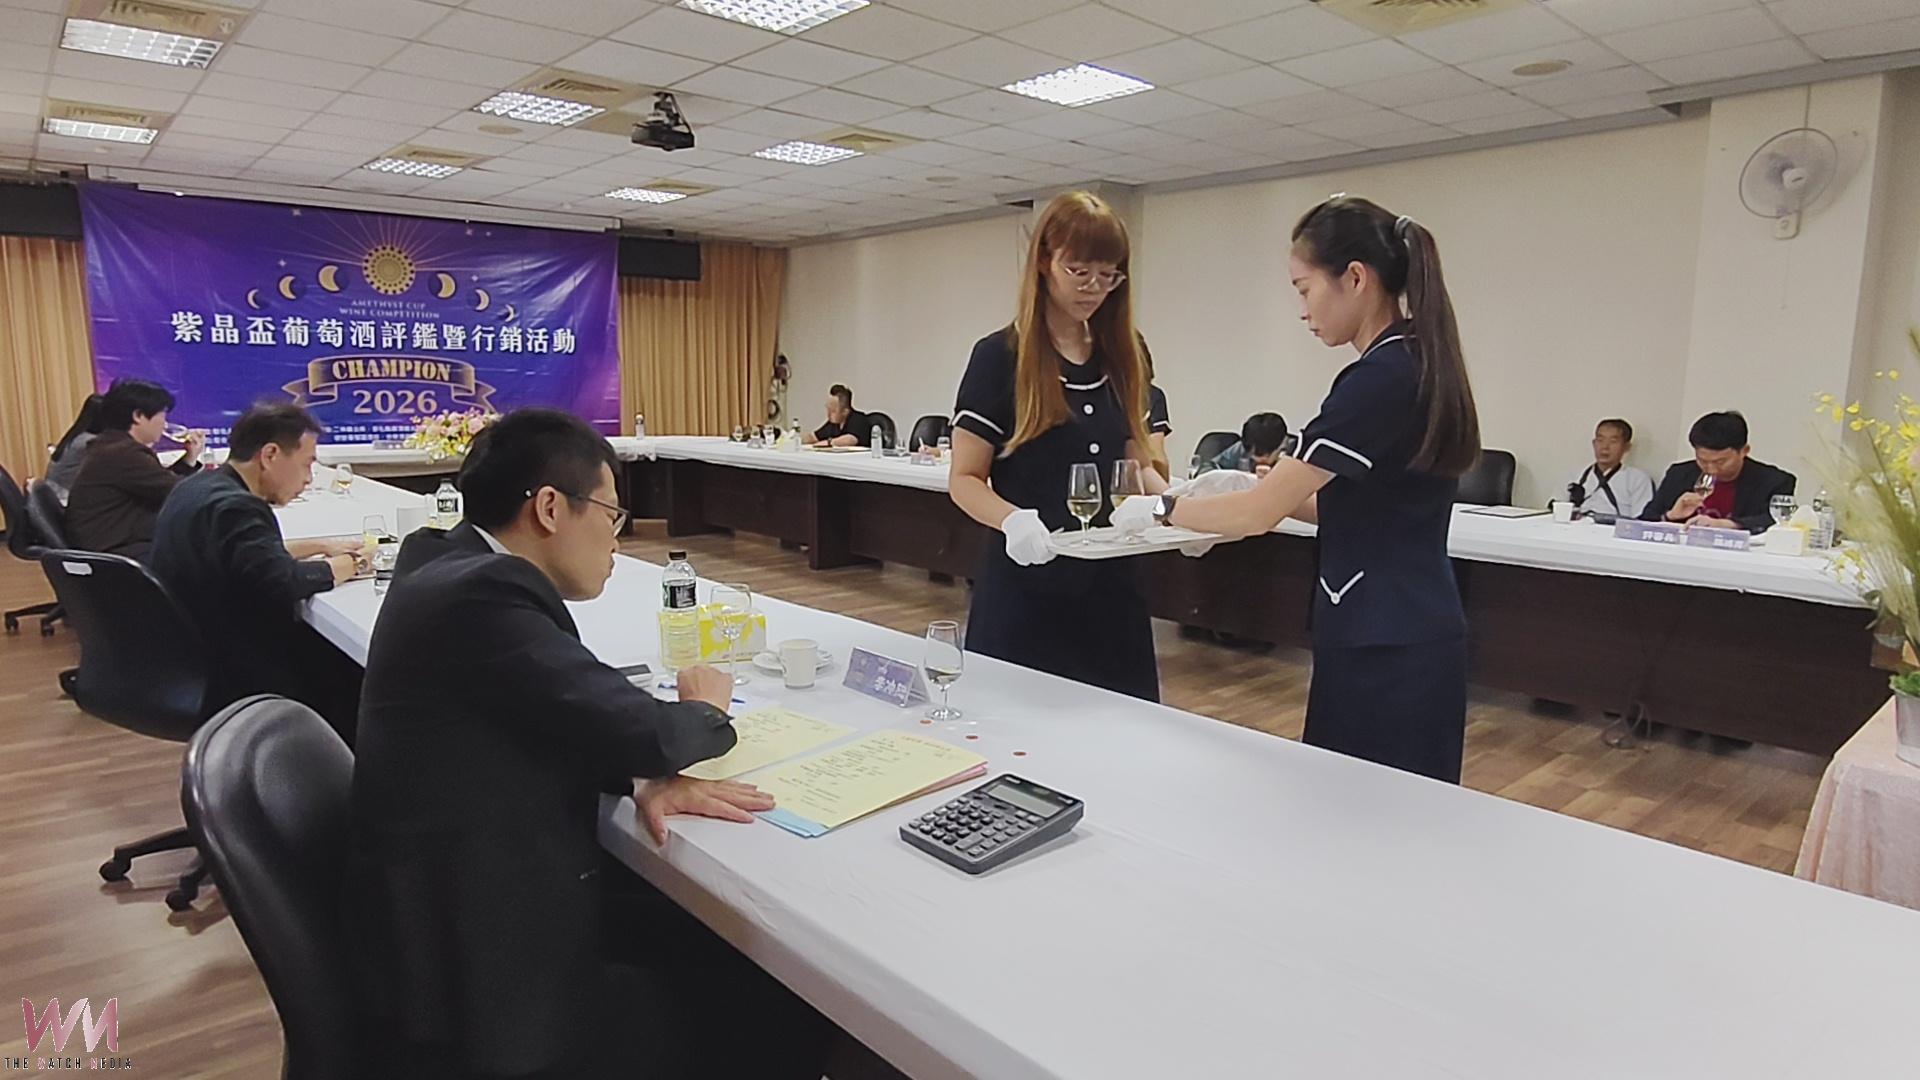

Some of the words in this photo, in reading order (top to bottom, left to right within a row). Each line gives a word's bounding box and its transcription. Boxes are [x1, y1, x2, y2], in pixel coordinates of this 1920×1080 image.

[339, 307, 366, 316] WINE
[370, 309, 440, 319] COMPETITION
[351, 299, 403, 309] AMETHYST
[406, 302, 426, 310] CUP
[170, 311, 576, 355] 紫晶盃葡萄酒評鑑暨行銷活動
[332, 358, 452, 383] CHAMPION
[353, 389, 438, 415] 2026
